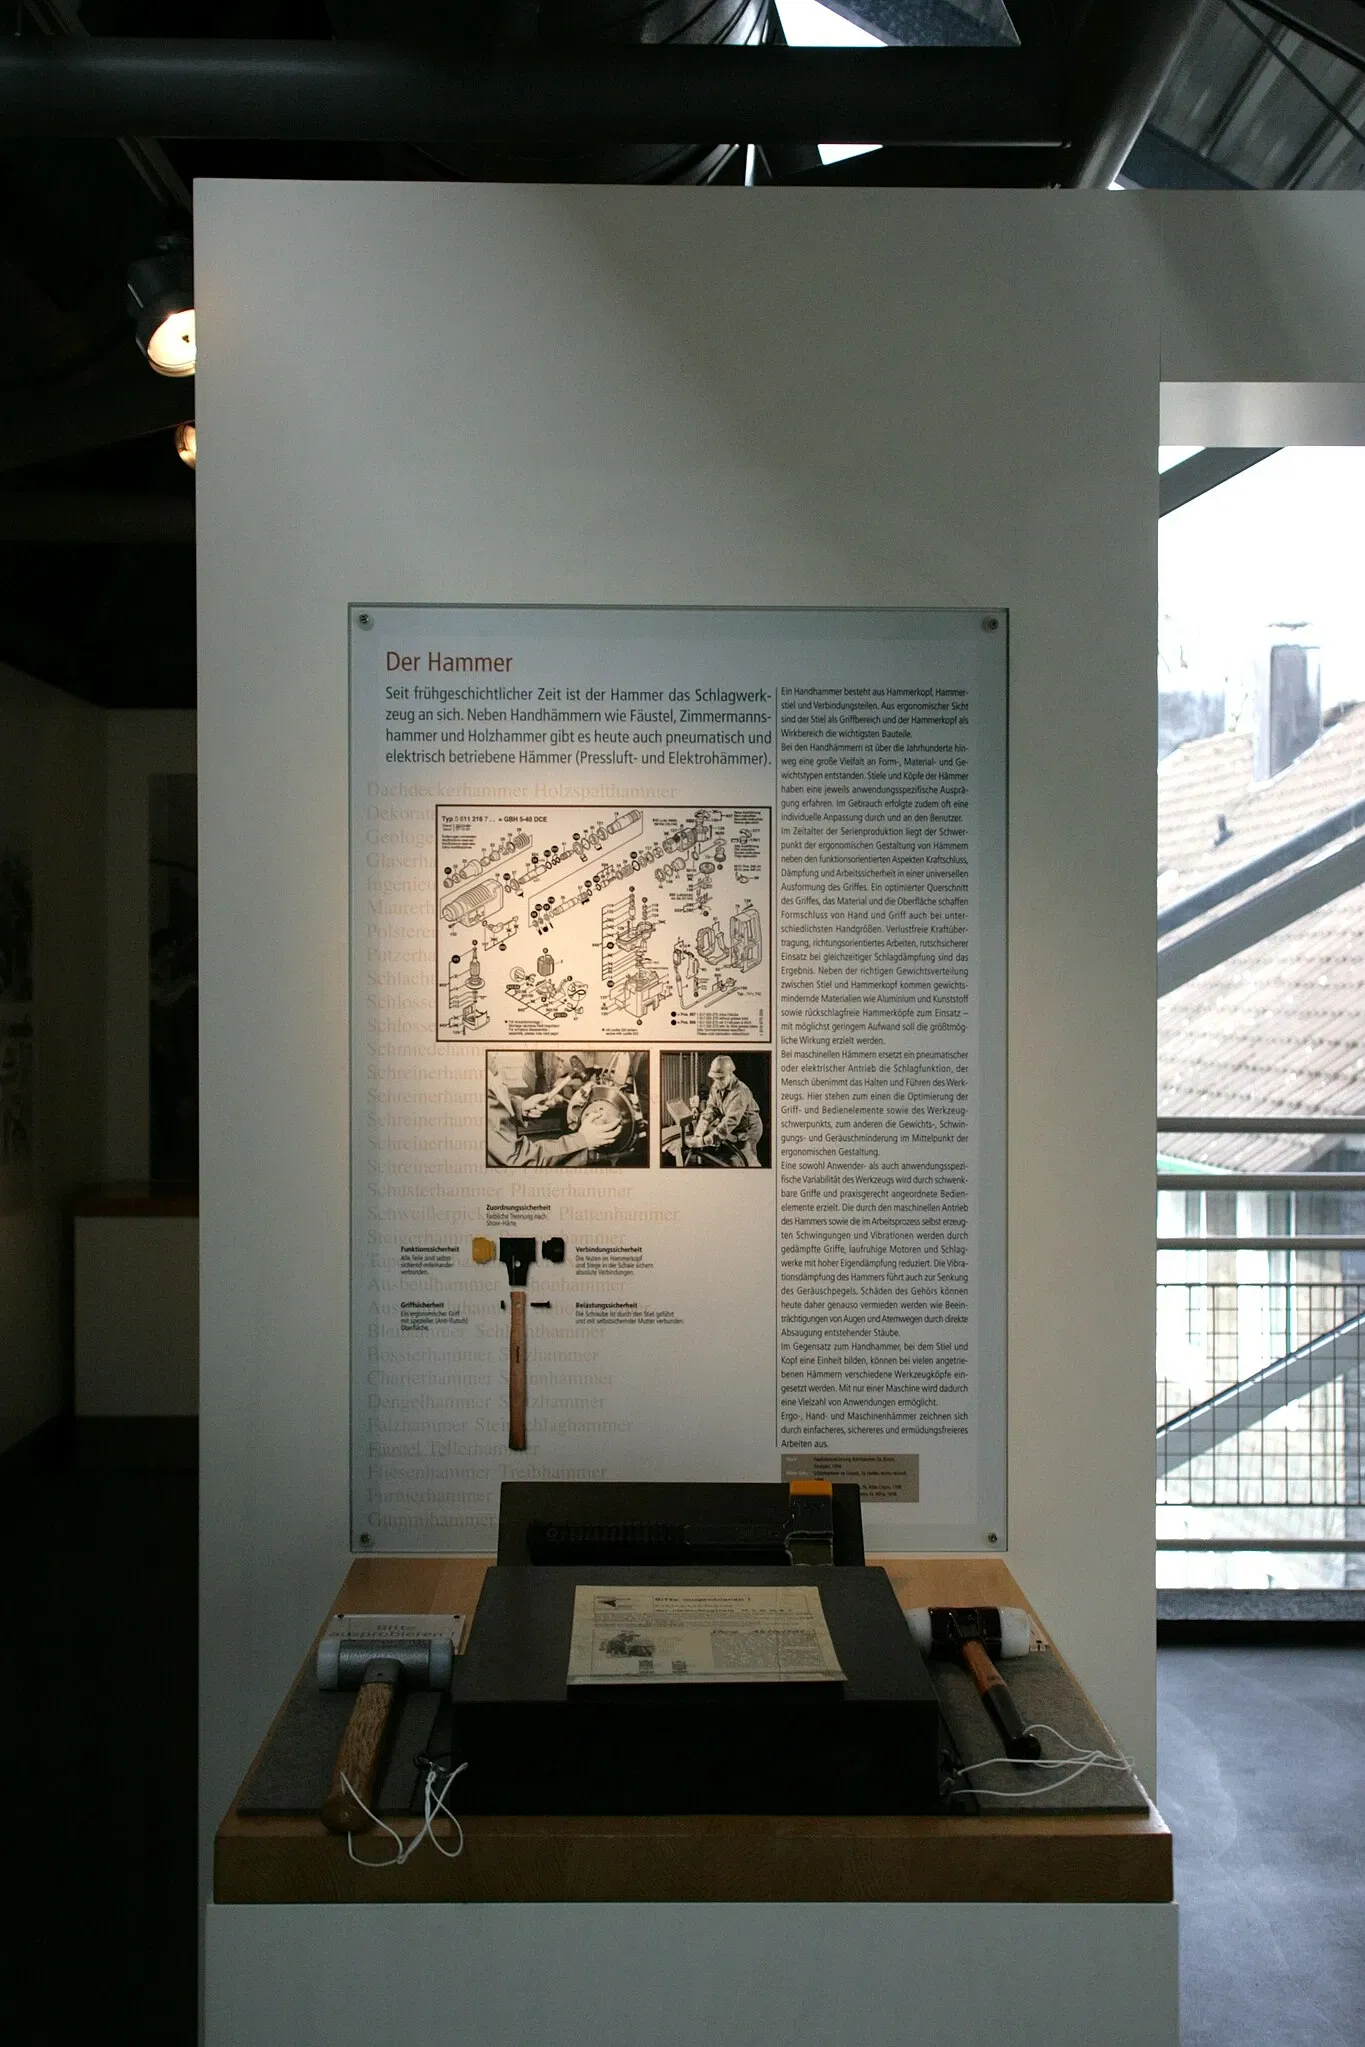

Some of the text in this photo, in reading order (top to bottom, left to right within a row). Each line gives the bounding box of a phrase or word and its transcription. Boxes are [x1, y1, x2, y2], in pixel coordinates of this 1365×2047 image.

[386, 652, 513, 672] Der Hammer
[386, 686, 771, 705] Seit frühgeschichtlicher Zeit ist der Hammer das Schlagwerk-
[781, 686, 792, 696] Ein
[794, 686, 842, 696] Handhammer
[844, 686, 870, 696] besteht
[886, 686, 934, 698] Hammerkopf,
[935, 686, 968, 696] Hammer-
[386, 707, 771, 726] zeug an sich. Neben Handhämmern wie Fäustel, Zimmermanns-
[386, 728, 772, 747] hammer und Holzhammer gibt es heute auch pneumatisch und
[781, 728, 912, 740] Wirkbereich die wichtigsten Bauteile.
[386, 749, 771, 768] elektrisch betriebene Hämmer (Pressluft- und Elektrohämmer).
[781, 770, 968, 782] wichtstypen entstanden. Stiele und Köpfe der Hämmer
[781, 812, 822, 822] individuelle
[823, 812, 863, 823] Anpassung
[864, 812, 885, 822] durch
[887, 812, 901, 822] und
[914, 812, 928, 822] den
[930, 812, 962, 822] Benutzer.
[781, 881, 968, 893] Ausformung des Griffes. Ein optimierter Querschnitt
[781, 951, 968, 963] Einsatz bei gleichzeitiger Schlagdämpfung sind das
[781, 1062, 968, 1074] oder elektrischer Antrieb die Schlagfunktion, der
[781, 1160, 968, 1172] Eine sowohl Anwender- als auch anwendungsspezi-
[781, 1229, 968, 1241] ten Schwingungen und Vibrationen werden durch
[781, 1285, 968, 1297] des Geräuschpegels. Schäden des Gehörs können
[781, 1341, 790, 1351] Im
[793, 1341, 831, 1353] Gegensatz
[852, 1341, 901, 1353] Handhammer,
[904, 1341, 915, 1351] bei
[918, 1341, 934, 1351] dem
[936, 1341, 952, 1351] Stiel
[954, 1341, 968, 1351] und
[781, 1410, 968, 1422] Ergo-, Hand- und Maschinenhämmer zeichnen sich
[781, 1438, 812, 1448] Arbeiten
